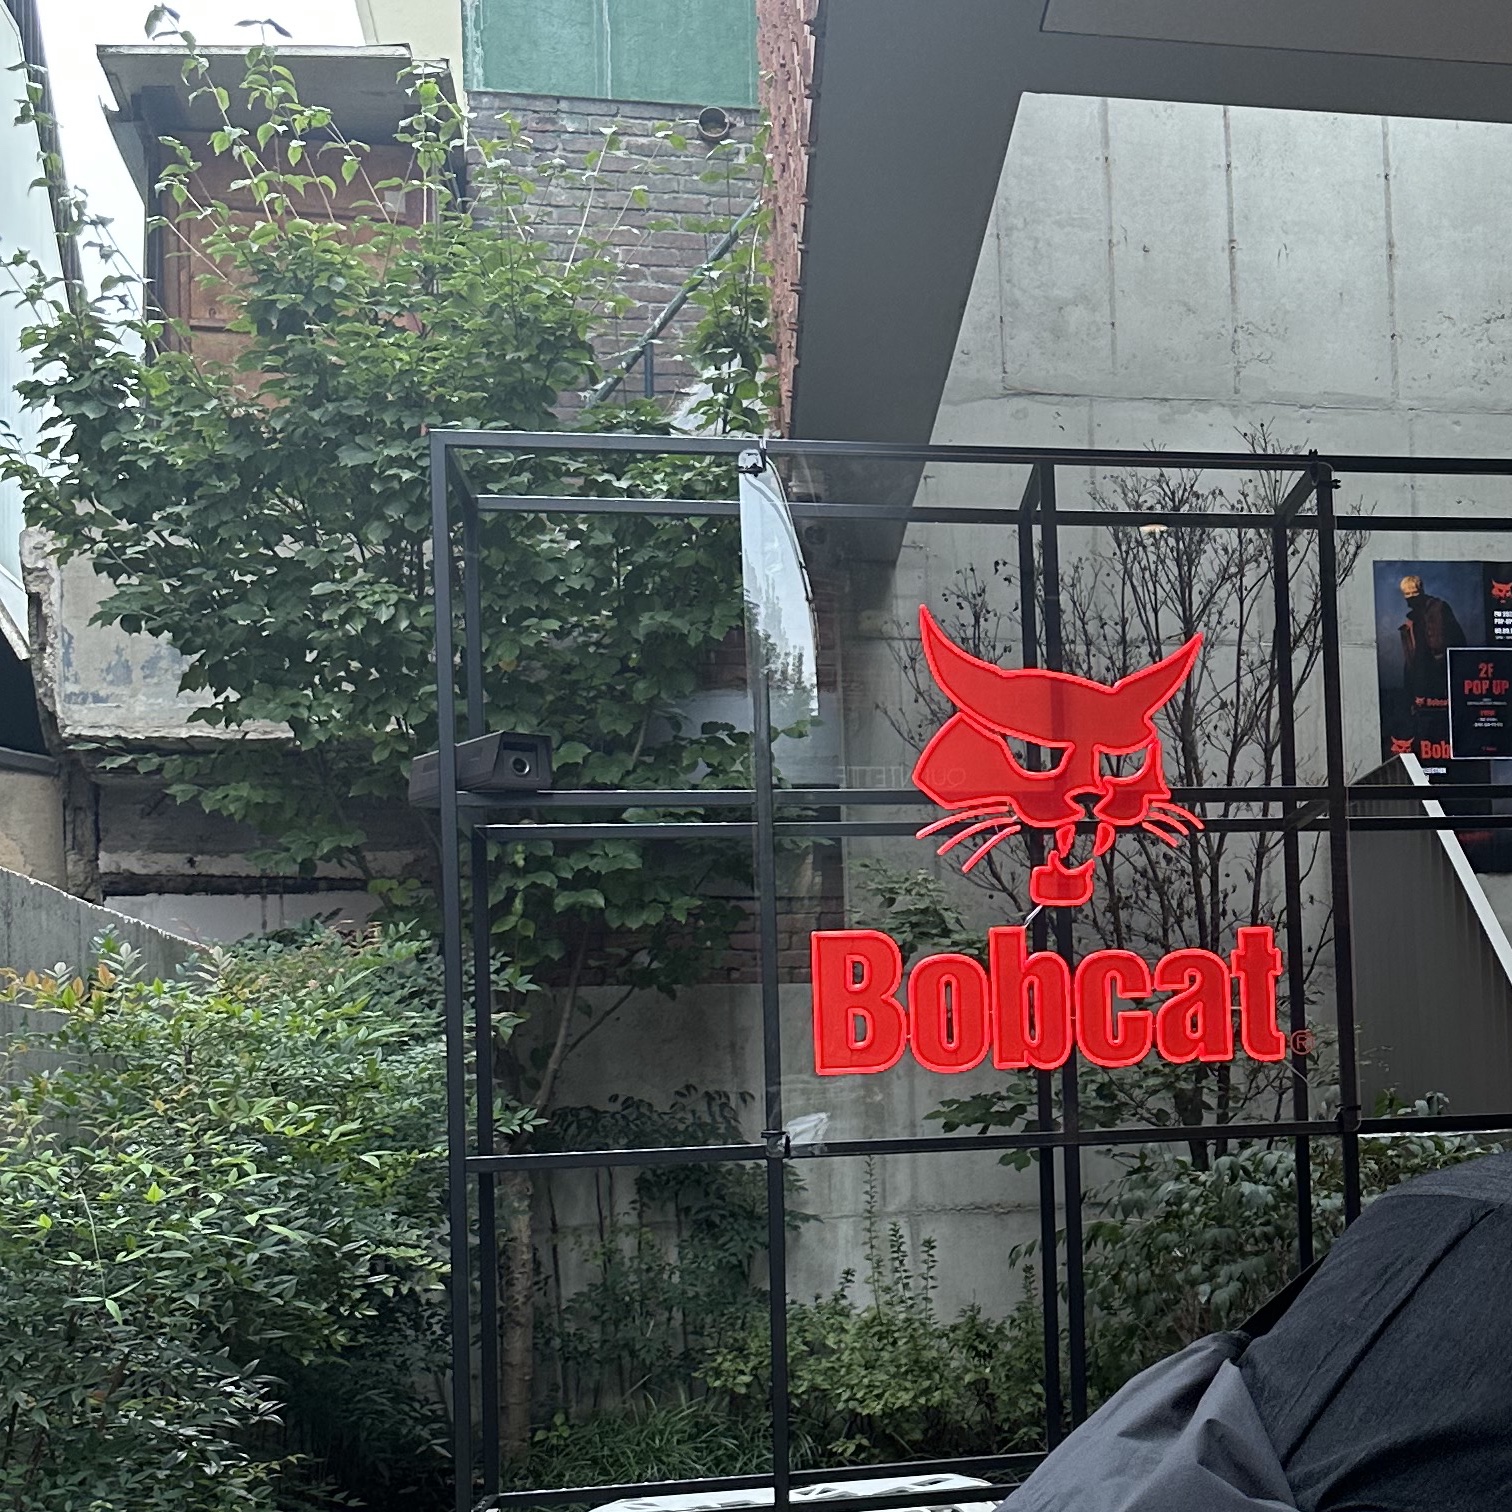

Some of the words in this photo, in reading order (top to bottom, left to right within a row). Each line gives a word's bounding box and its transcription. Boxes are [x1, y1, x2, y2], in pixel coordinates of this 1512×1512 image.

[1478, 663, 1494, 678] 2F
[1464, 680, 1489, 695] POP
[1493, 680, 1509, 695] UP
[1420, 740, 1450, 759] Bob
